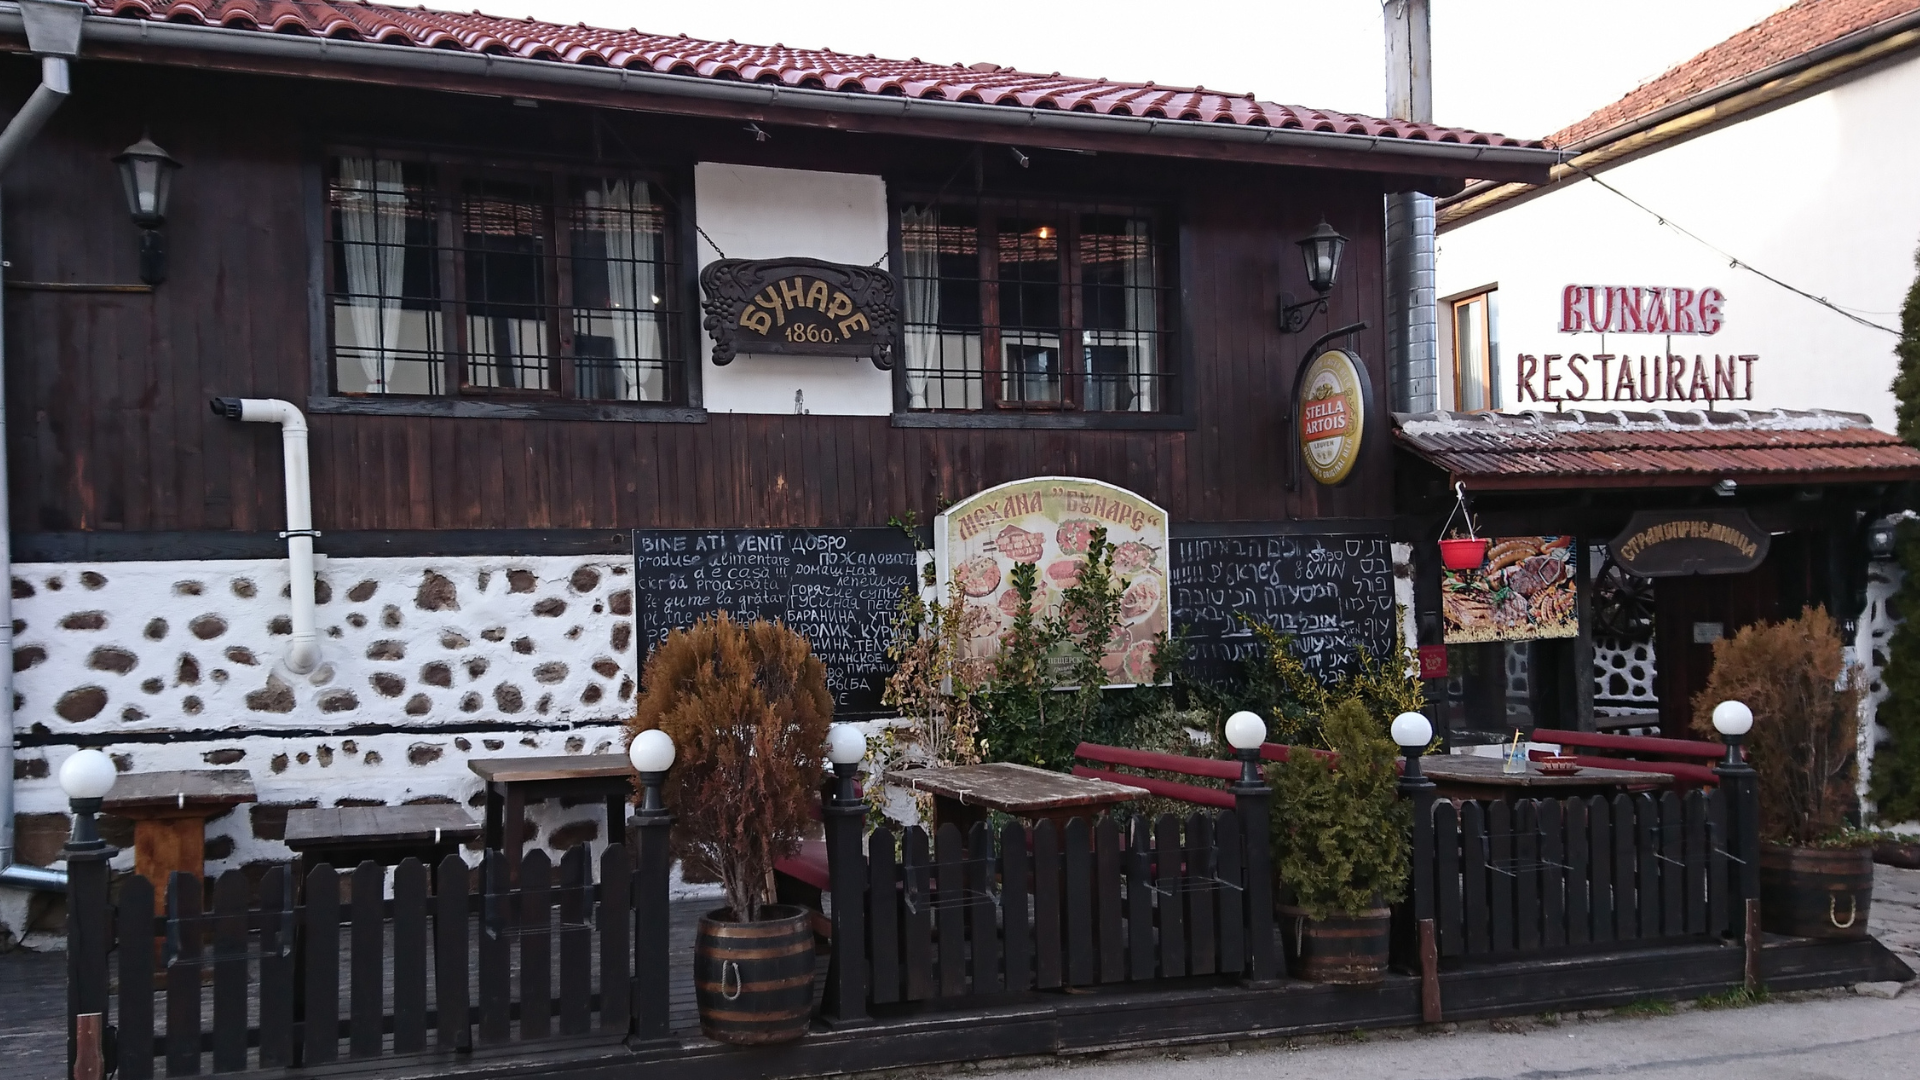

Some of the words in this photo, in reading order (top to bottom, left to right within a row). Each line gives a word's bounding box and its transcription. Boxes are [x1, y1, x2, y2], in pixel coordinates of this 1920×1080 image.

[739, 276, 871, 340] БУНАРЕ
[1558, 284, 1725, 336] BUNARE
[1516, 353, 1759, 403] RESTAURANT
[1305, 400, 1345, 420] STELLA
[1305, 415, 1347, 435] ARTOIS
[957, 490, 1044, 541] МЕХАНА
[792, 535, 847, 555] ДОБРО
[638, 552, 701, 570] produse
[827, 678, 871, 692] РЫБА
